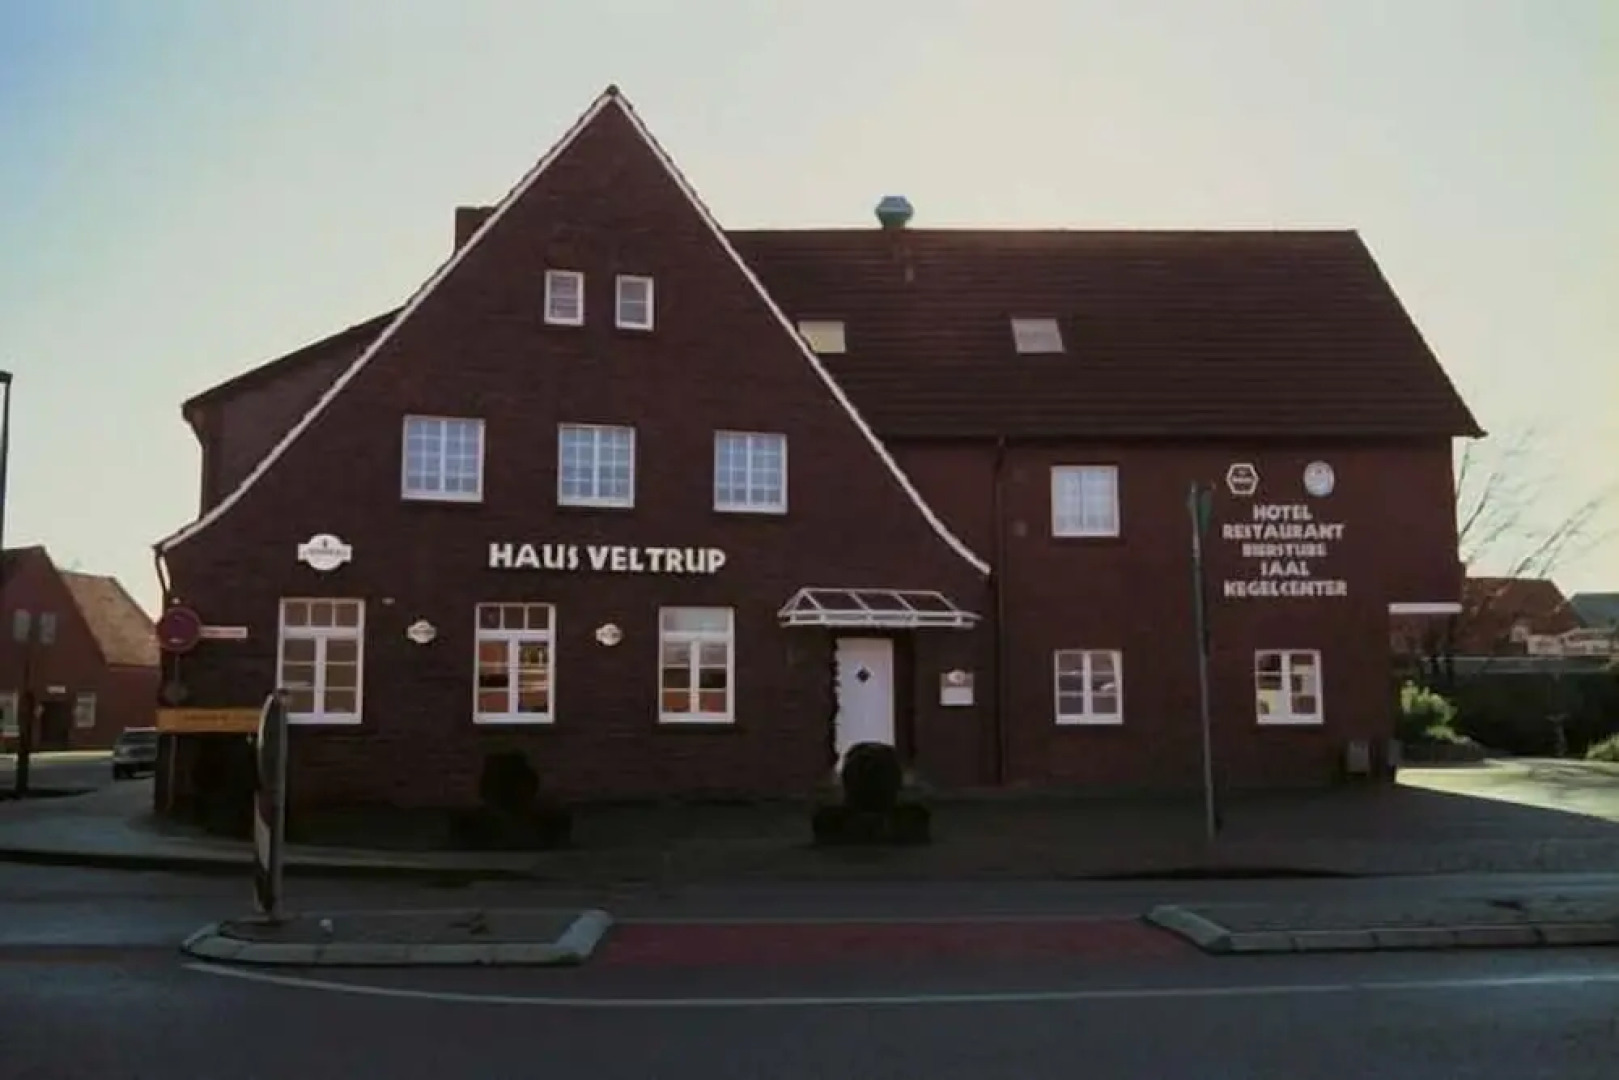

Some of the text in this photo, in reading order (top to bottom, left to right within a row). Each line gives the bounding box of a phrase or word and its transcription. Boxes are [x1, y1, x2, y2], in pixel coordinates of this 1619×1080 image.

[1253, 504, 1313, 520] HOTEL
[1222, 523, 1345, 539] RESTAURANT
[488, 543, 727, 573] HAUS VELTRUP
[1242, 543, 1327, 557] BIERSTUBE
[1260, 560, 1310, 576] SAAL
[1223, 580, 1348, 597] KEGELCENTER
